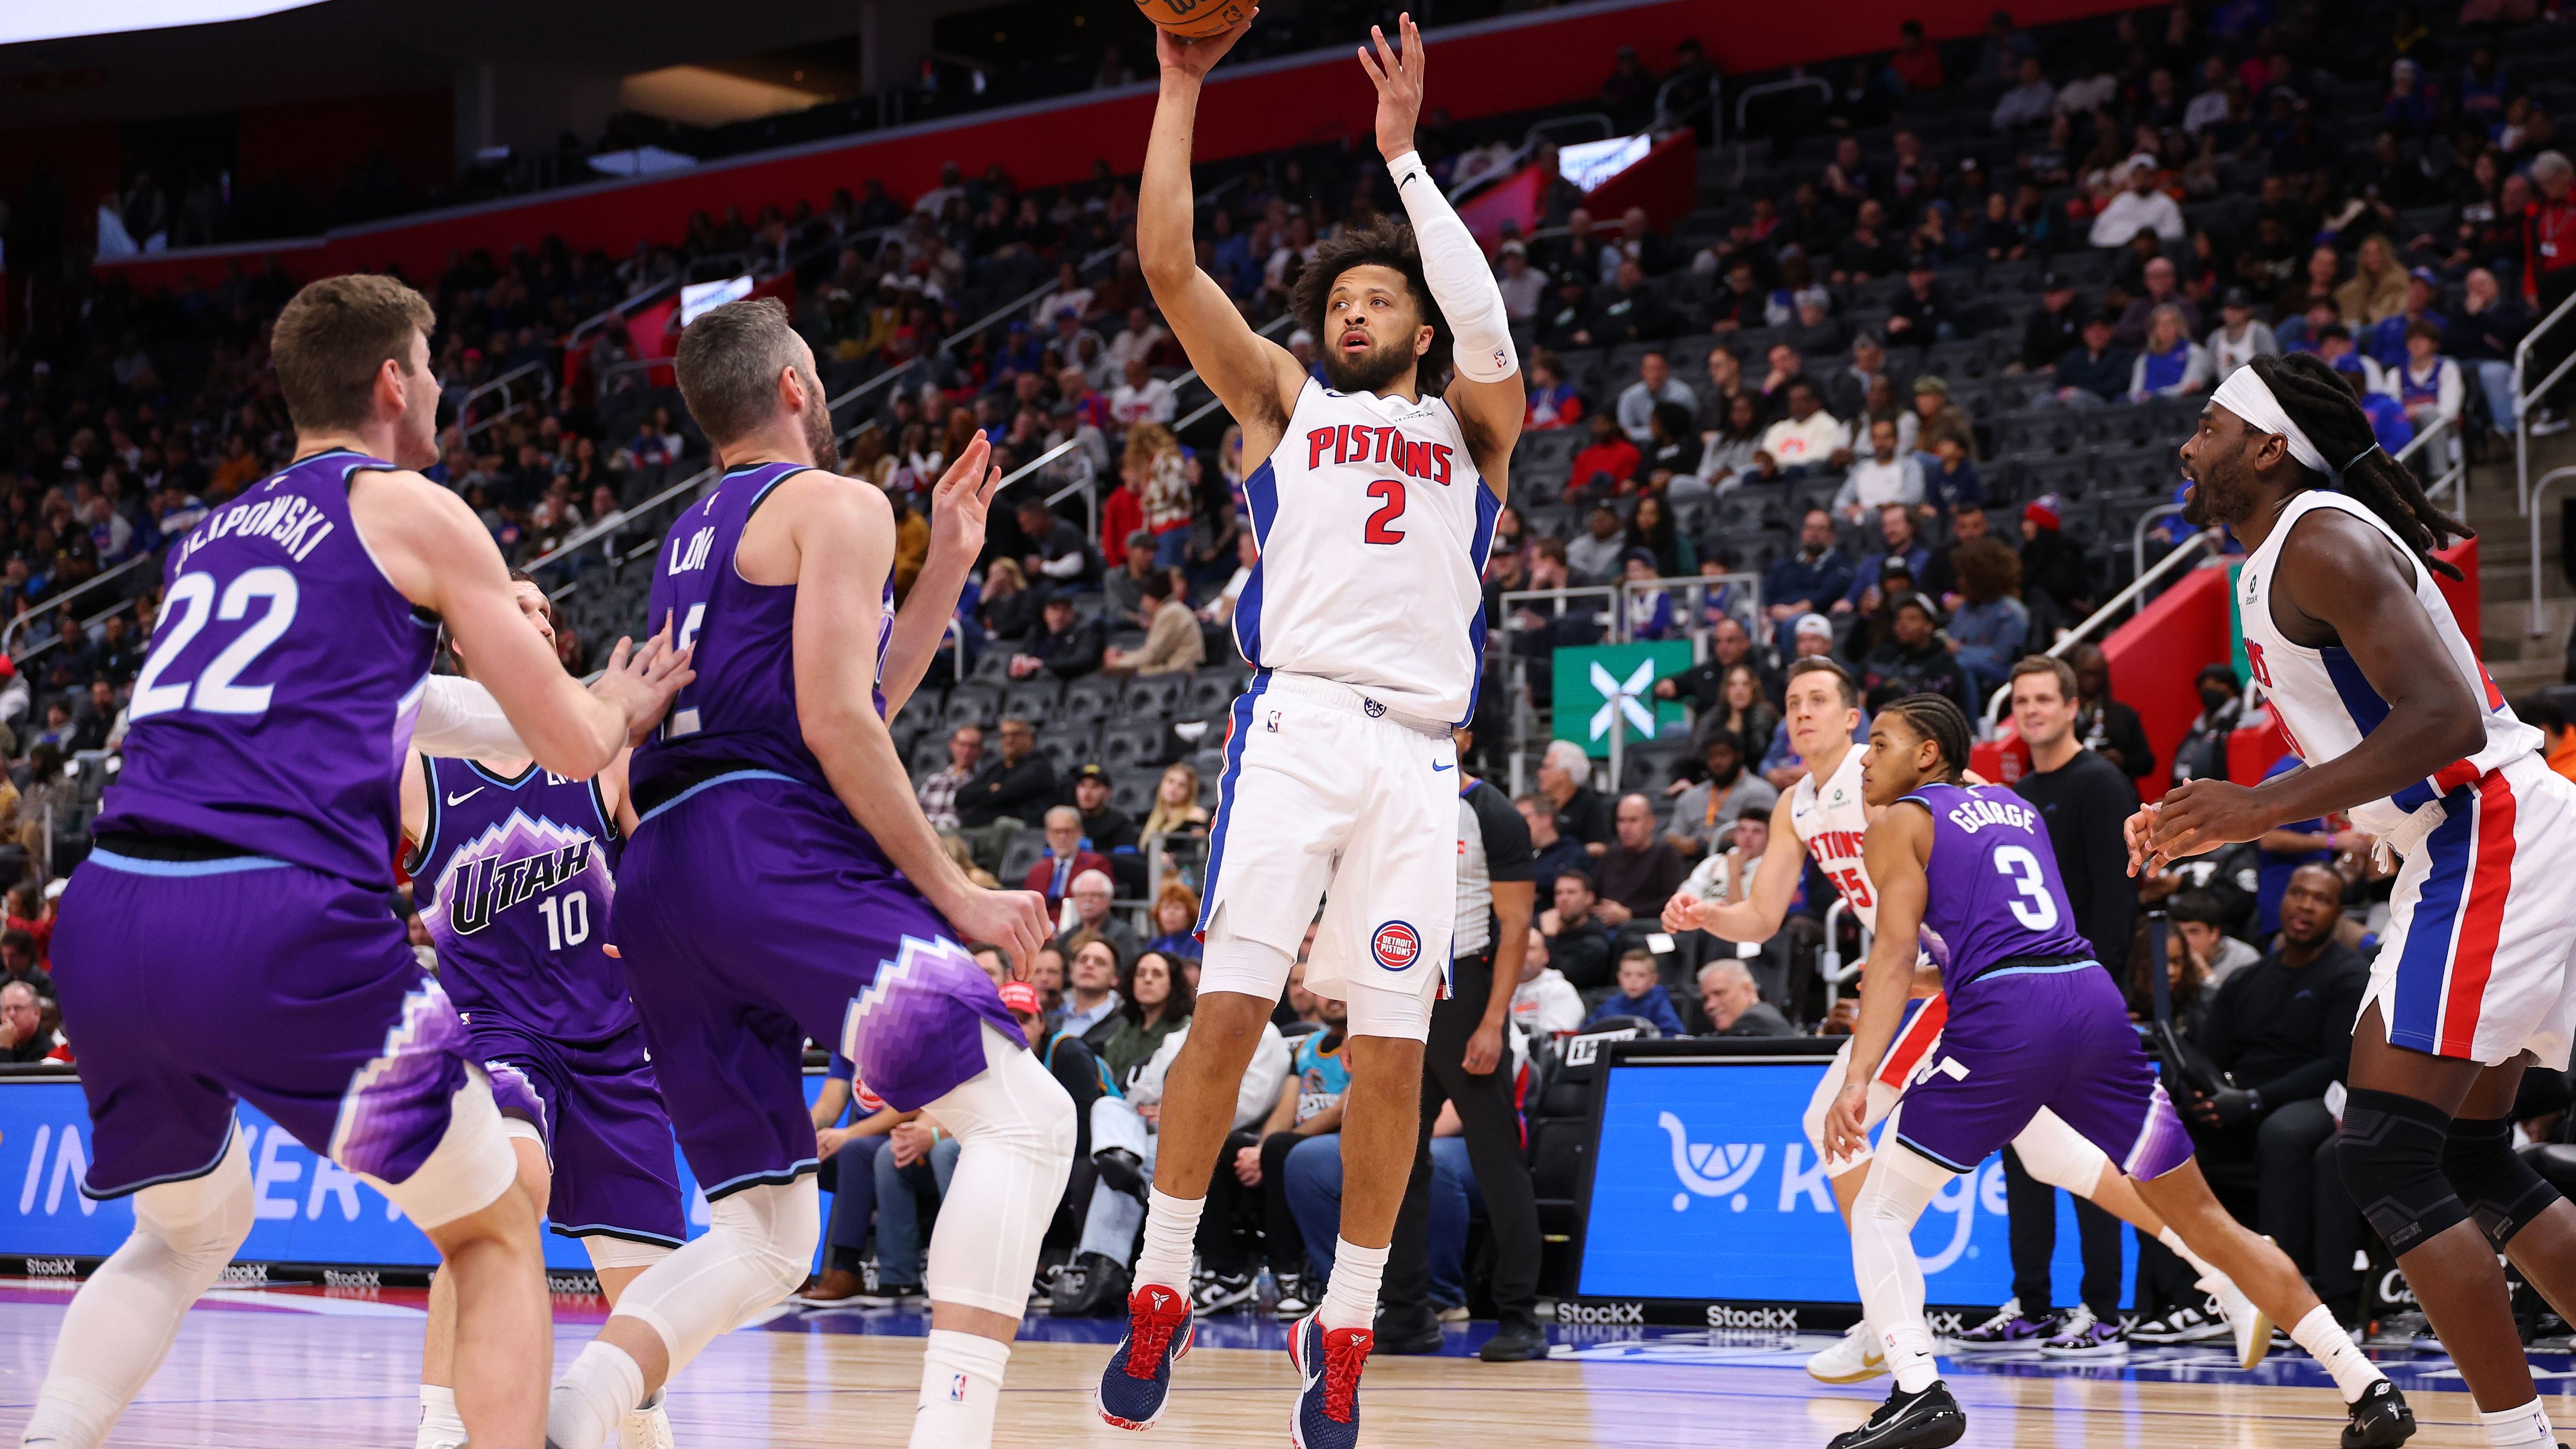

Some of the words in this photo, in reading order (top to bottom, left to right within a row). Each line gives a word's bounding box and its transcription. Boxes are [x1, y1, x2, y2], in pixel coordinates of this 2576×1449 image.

[1307, 425, 1453, 486] PISTONS
[1364, 480, 1406, 545] 2
[128, 566, 300, 722] 22
[1949, 799, 2036, 835] GEORGE
[1810, 831, 1864, 863] STONS
[1993, 844, 2059, 931] 3
[538, 889, 589, 951] 10
[1380, 943, 1411, 957] PISTONS
[1382, 935, 1412, 949] DETROIT
[26, 1258, 76, 1276] StockX
[323, 1270, 381, 1287] StockX
[547, 1275, 601, 1294] tockX
[1557, 1302, 1644, 1323] StockX
[1706, 1304, 1798, 1330] StockX
